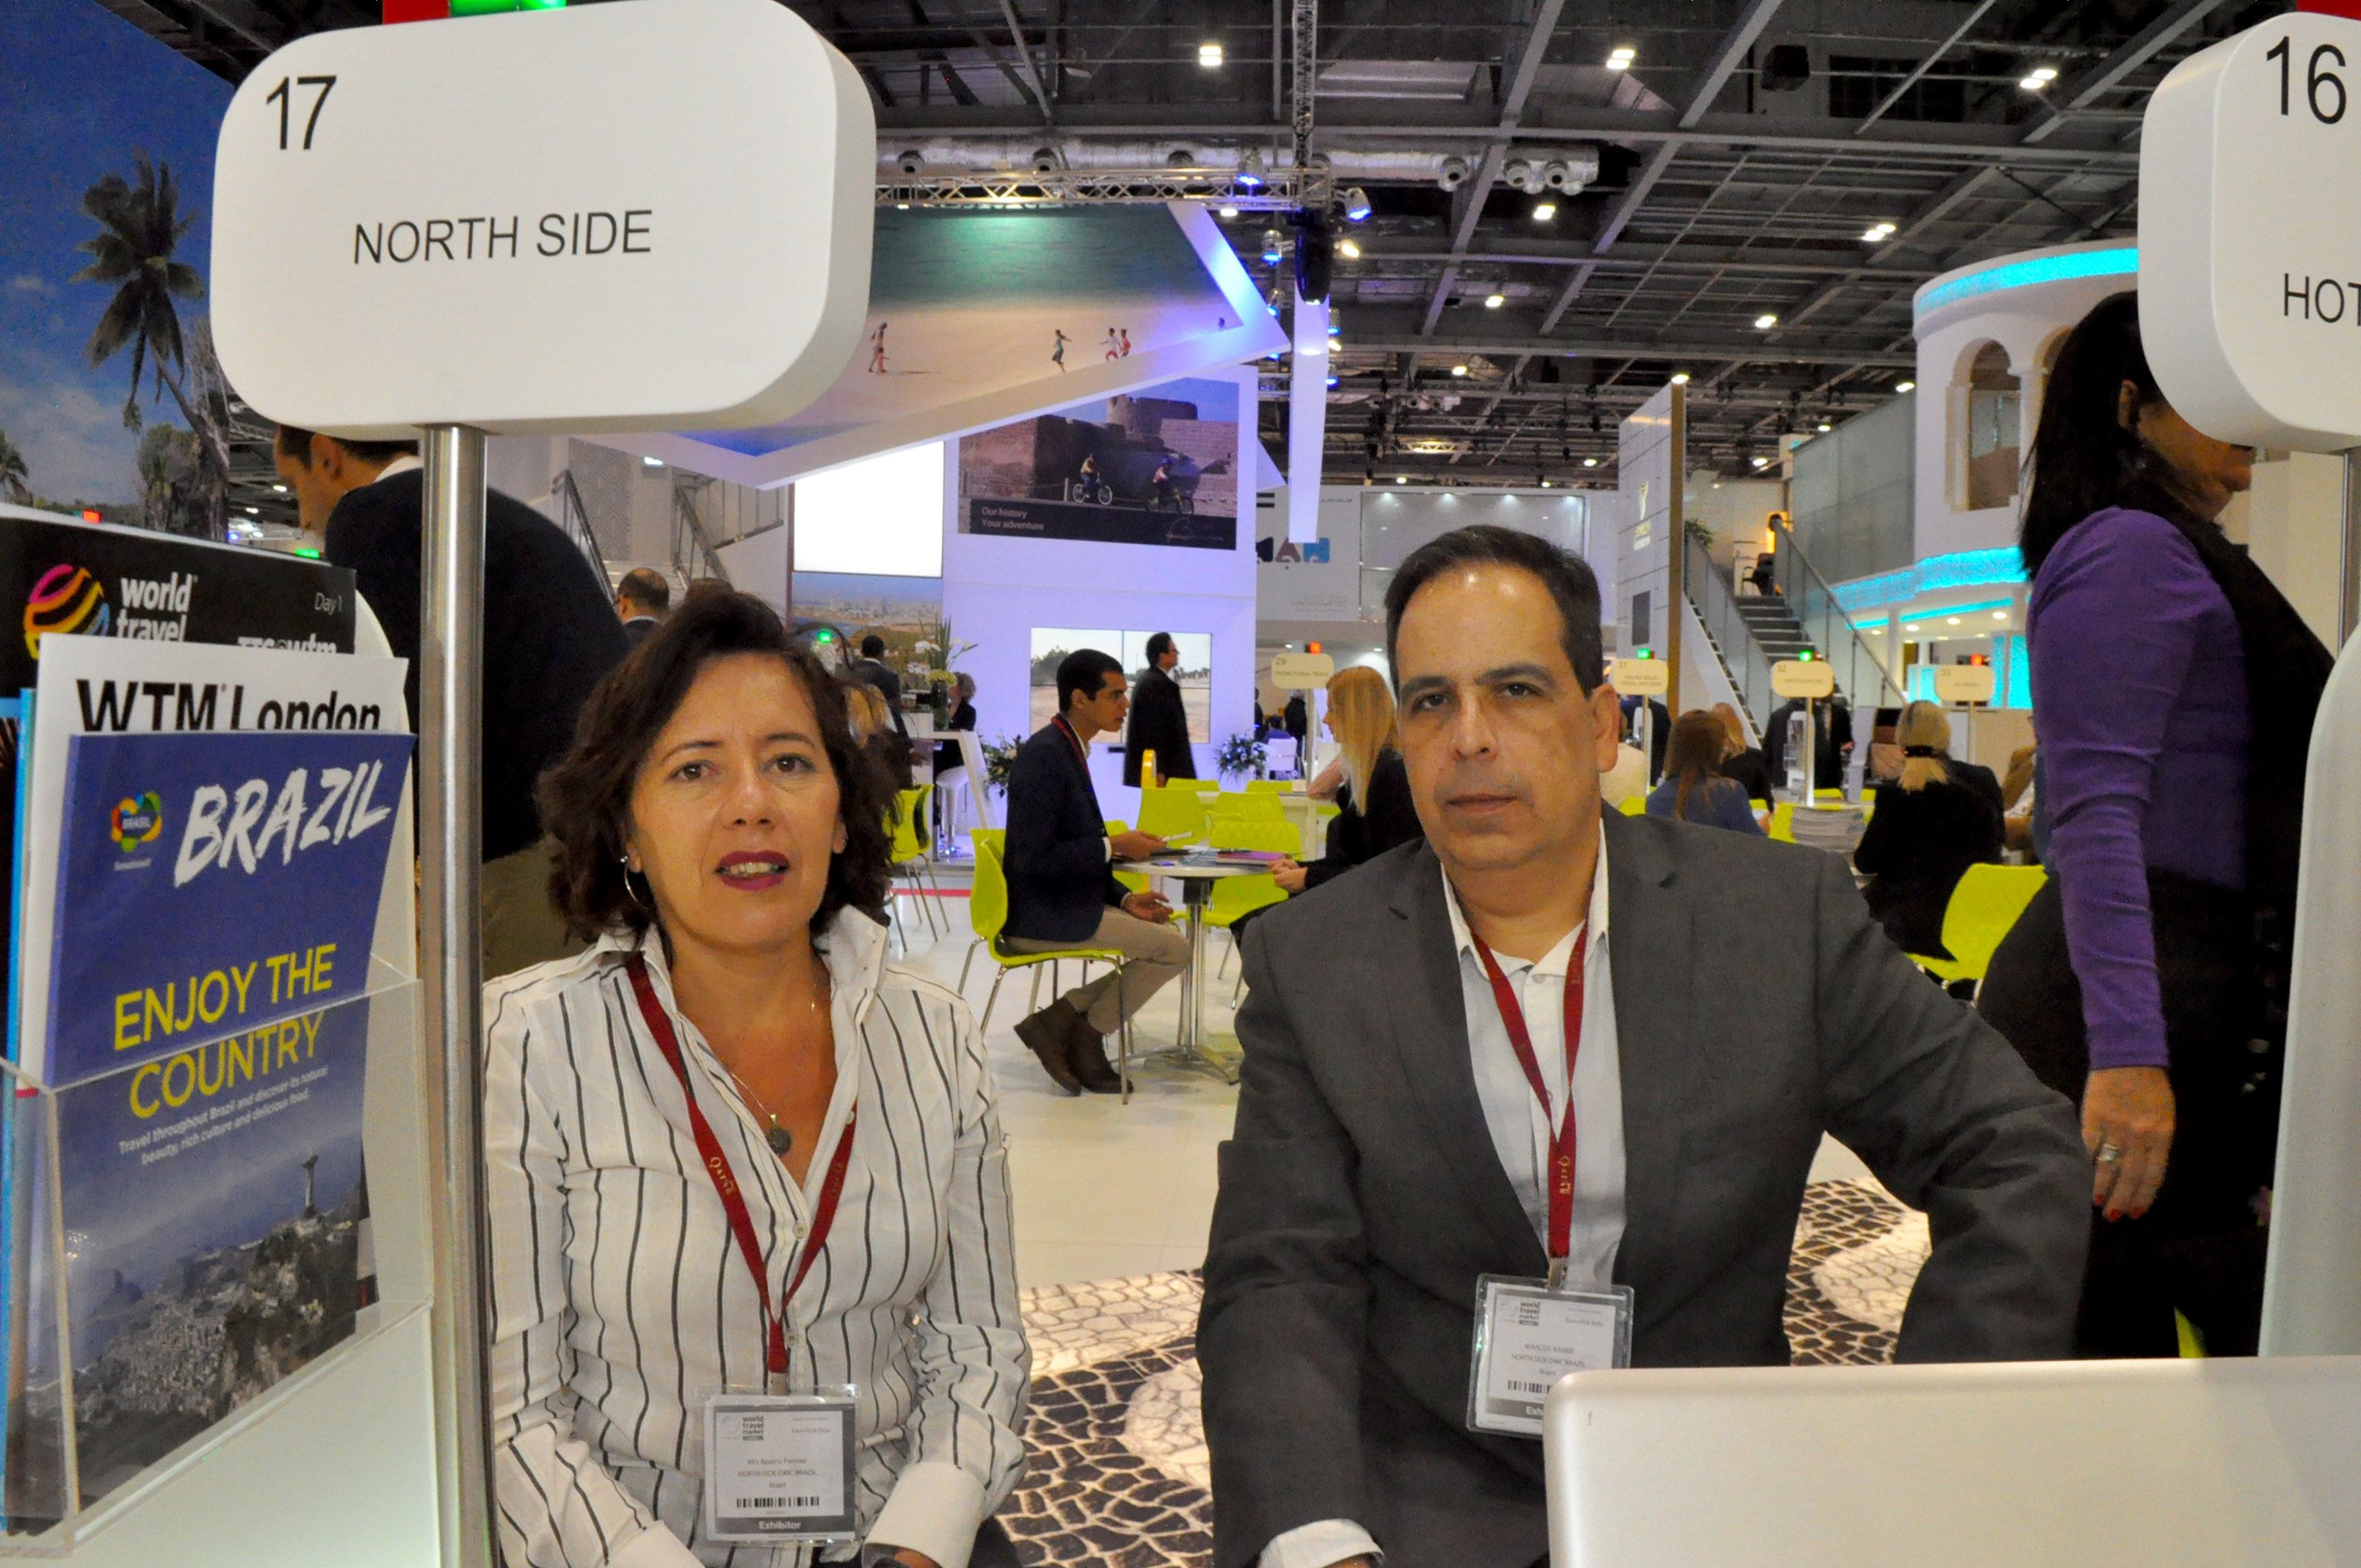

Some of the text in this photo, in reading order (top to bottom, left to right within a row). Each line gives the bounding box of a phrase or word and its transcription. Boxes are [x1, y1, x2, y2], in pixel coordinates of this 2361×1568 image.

[2266, 35, 2346, 125] 16
[265, 74, 338, 150] 17
[354, 208, 653, 265] NORTH SIDE
[982, 507, 1028, 519] Our history
[982, 518, 1045, 530] Your adventure
[120, 571, 192, 612] world
[314, 592, 336, 616] Day
[116, 608, 187, 642] travel
[1276, 657, 1286, 665] 29
[230, 684, 381, 731] London
[174, 759, 391, 888] BRAZIL
[113, 943, 337, 1051] ENJOY THE
[129, 1011, 324, 1119] COUNTRY
[118, 1130, 151, 1155] Travel
[152, 1111, 208, 1142] throughout
[758, 1520, 802, 1530] Exhibitor
